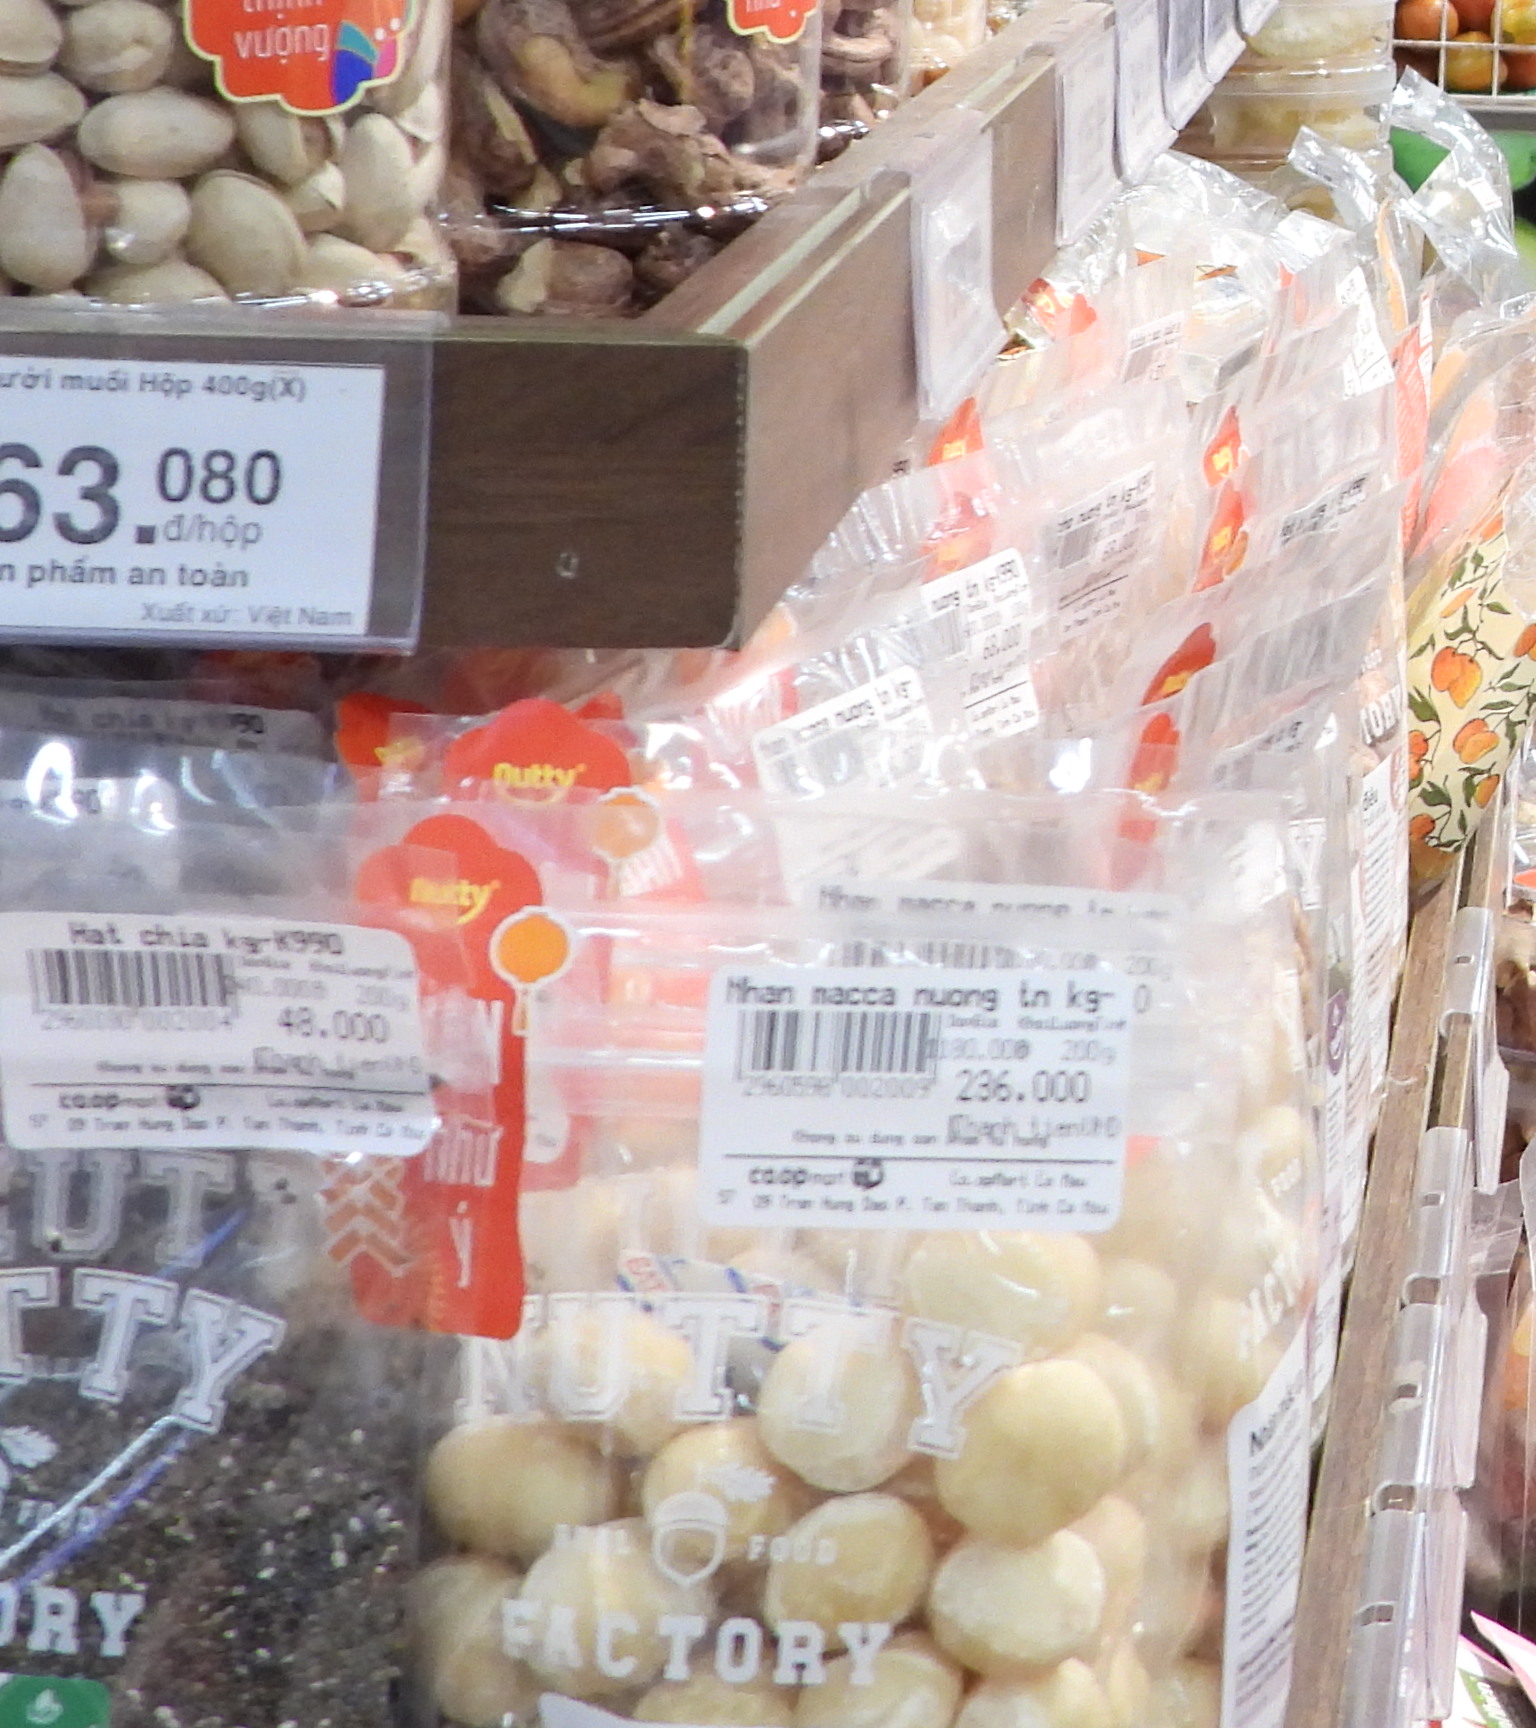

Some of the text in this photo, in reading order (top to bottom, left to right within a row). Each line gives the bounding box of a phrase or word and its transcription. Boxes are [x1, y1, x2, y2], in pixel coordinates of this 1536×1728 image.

[231, 16, 332, 62] vượng
[138, 371, 193, 399] Hộp
[202, 374, 308, 404] 400g(X)
[156, 446, 283, 506] 080
[163, 513, 264, 551] đ/hộp
[26, 556, 250, 590] phẩm an toàn
[297, 606, 353, 628] Nam
[810, 983, 897, 1007] macca
[912, 984, 999, 1011] nuong
[955, 1068, 1093, 1105] 236.000
[500, 1596, 894, 1687] FACTORY
